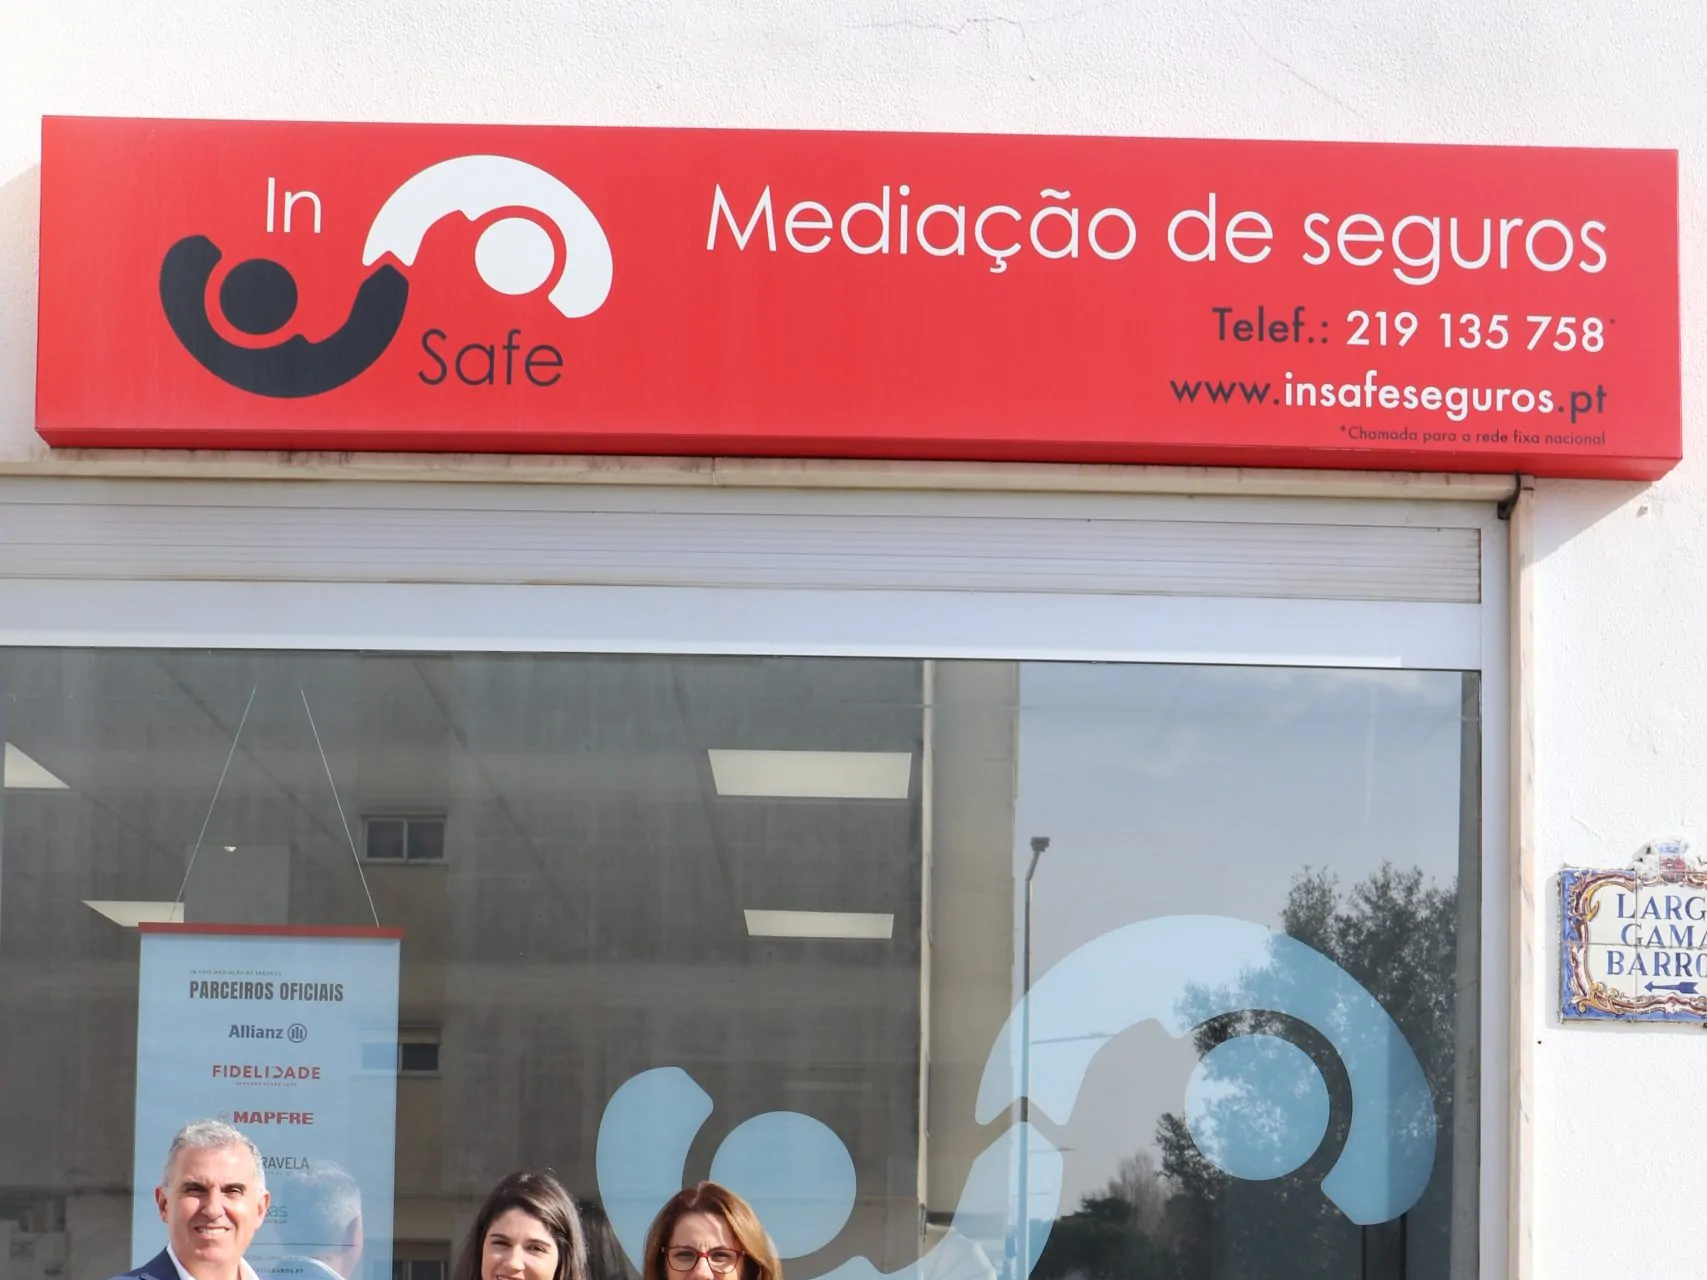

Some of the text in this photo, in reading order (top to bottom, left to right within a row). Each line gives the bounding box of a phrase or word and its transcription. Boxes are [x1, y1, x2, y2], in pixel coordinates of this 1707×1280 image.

[265, 176, 321, 233] In
[706, 184, 1608, 286] Mediação de seguros
[1212, 304, 1329, 344] Telef.:
[1346, 310, 1419, 347] 219
[1439, 313, 1510, 350] 135
[418, 329, 563, 387] Safe
[1170, 370, 1608, 423] www.insafeseguros.pt
[1423, 431, 1456, 444] para
[1462, 433, 1471, 442] a
[1476, 430, 1508, 443] rede
[1513, 431, 1540, 444] fixa
[1544, 432, 1605, 446] nacional
[189, 981, 344, 1002] PARCEIROS OFICIAIS
[229, 1025, 284, 1039] Allianz
[212, 1065, 321, 1080] FIDELIDADE
[233, 1111, 314, 1125] MAPFRE
[261, 1157, 310, 1170] RAVELA
